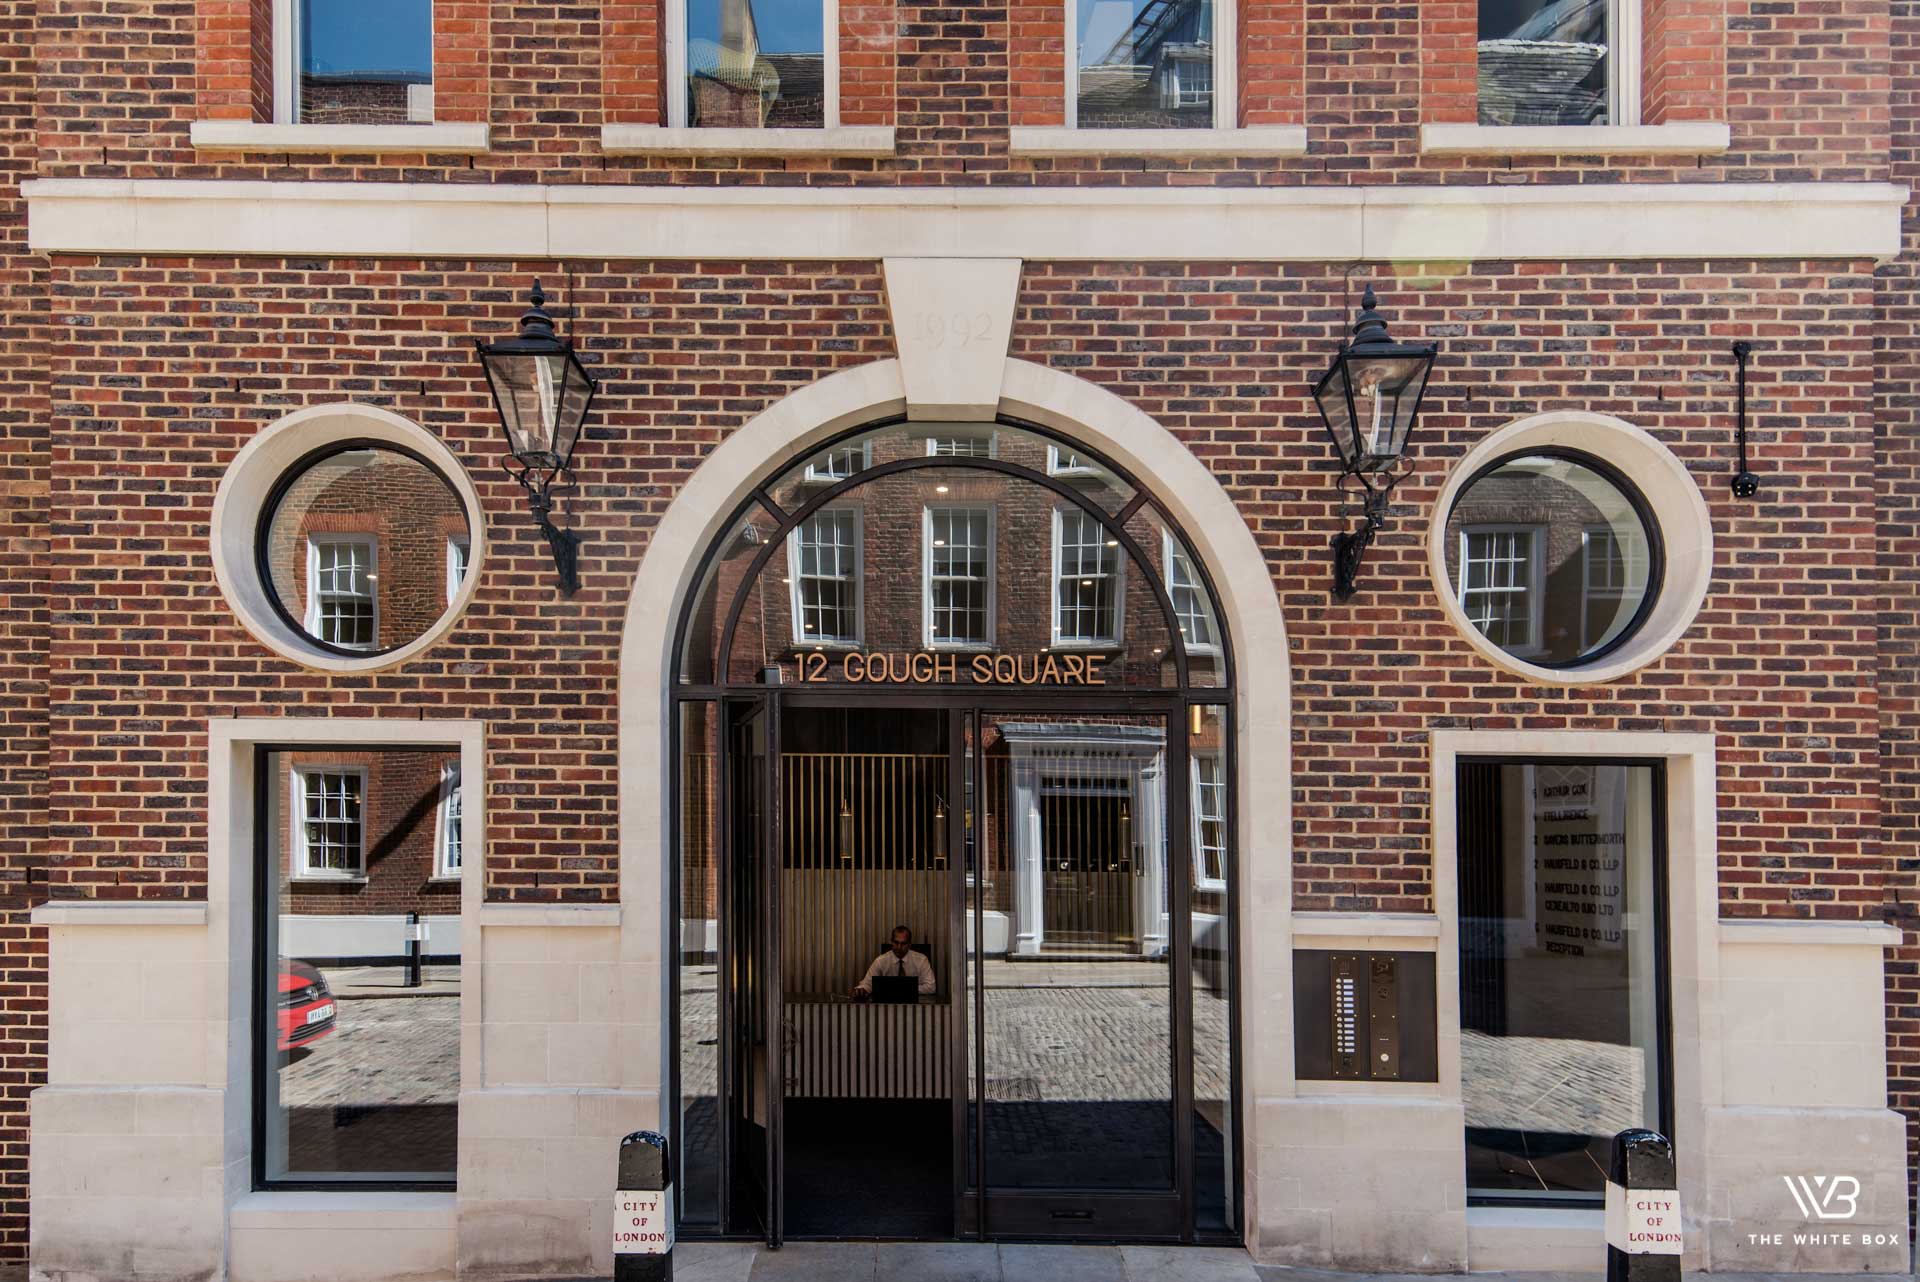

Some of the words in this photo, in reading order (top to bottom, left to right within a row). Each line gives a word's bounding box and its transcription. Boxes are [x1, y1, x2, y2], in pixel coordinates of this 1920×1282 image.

[912, 312, 992, 349] 1992
[794, 652, 828, 682] 12
[843, 652, 957, 684] GOUGH
[971, 654, 1107, 685] SQUARE
[1571, 784, 1587, 795] COX
[1599, 904, 1614, 916] LTD
[623, 1202, 656, 1211] CITY
[1637, 1201, 1672, 1211] CITY
[632, 1218, 648, 1226] OF
[1647, 1217, 1663, 1226] OF
[615, 1233, 665, 1241] LONDON
[1630, 1232, 1681, 1242] LONDON
